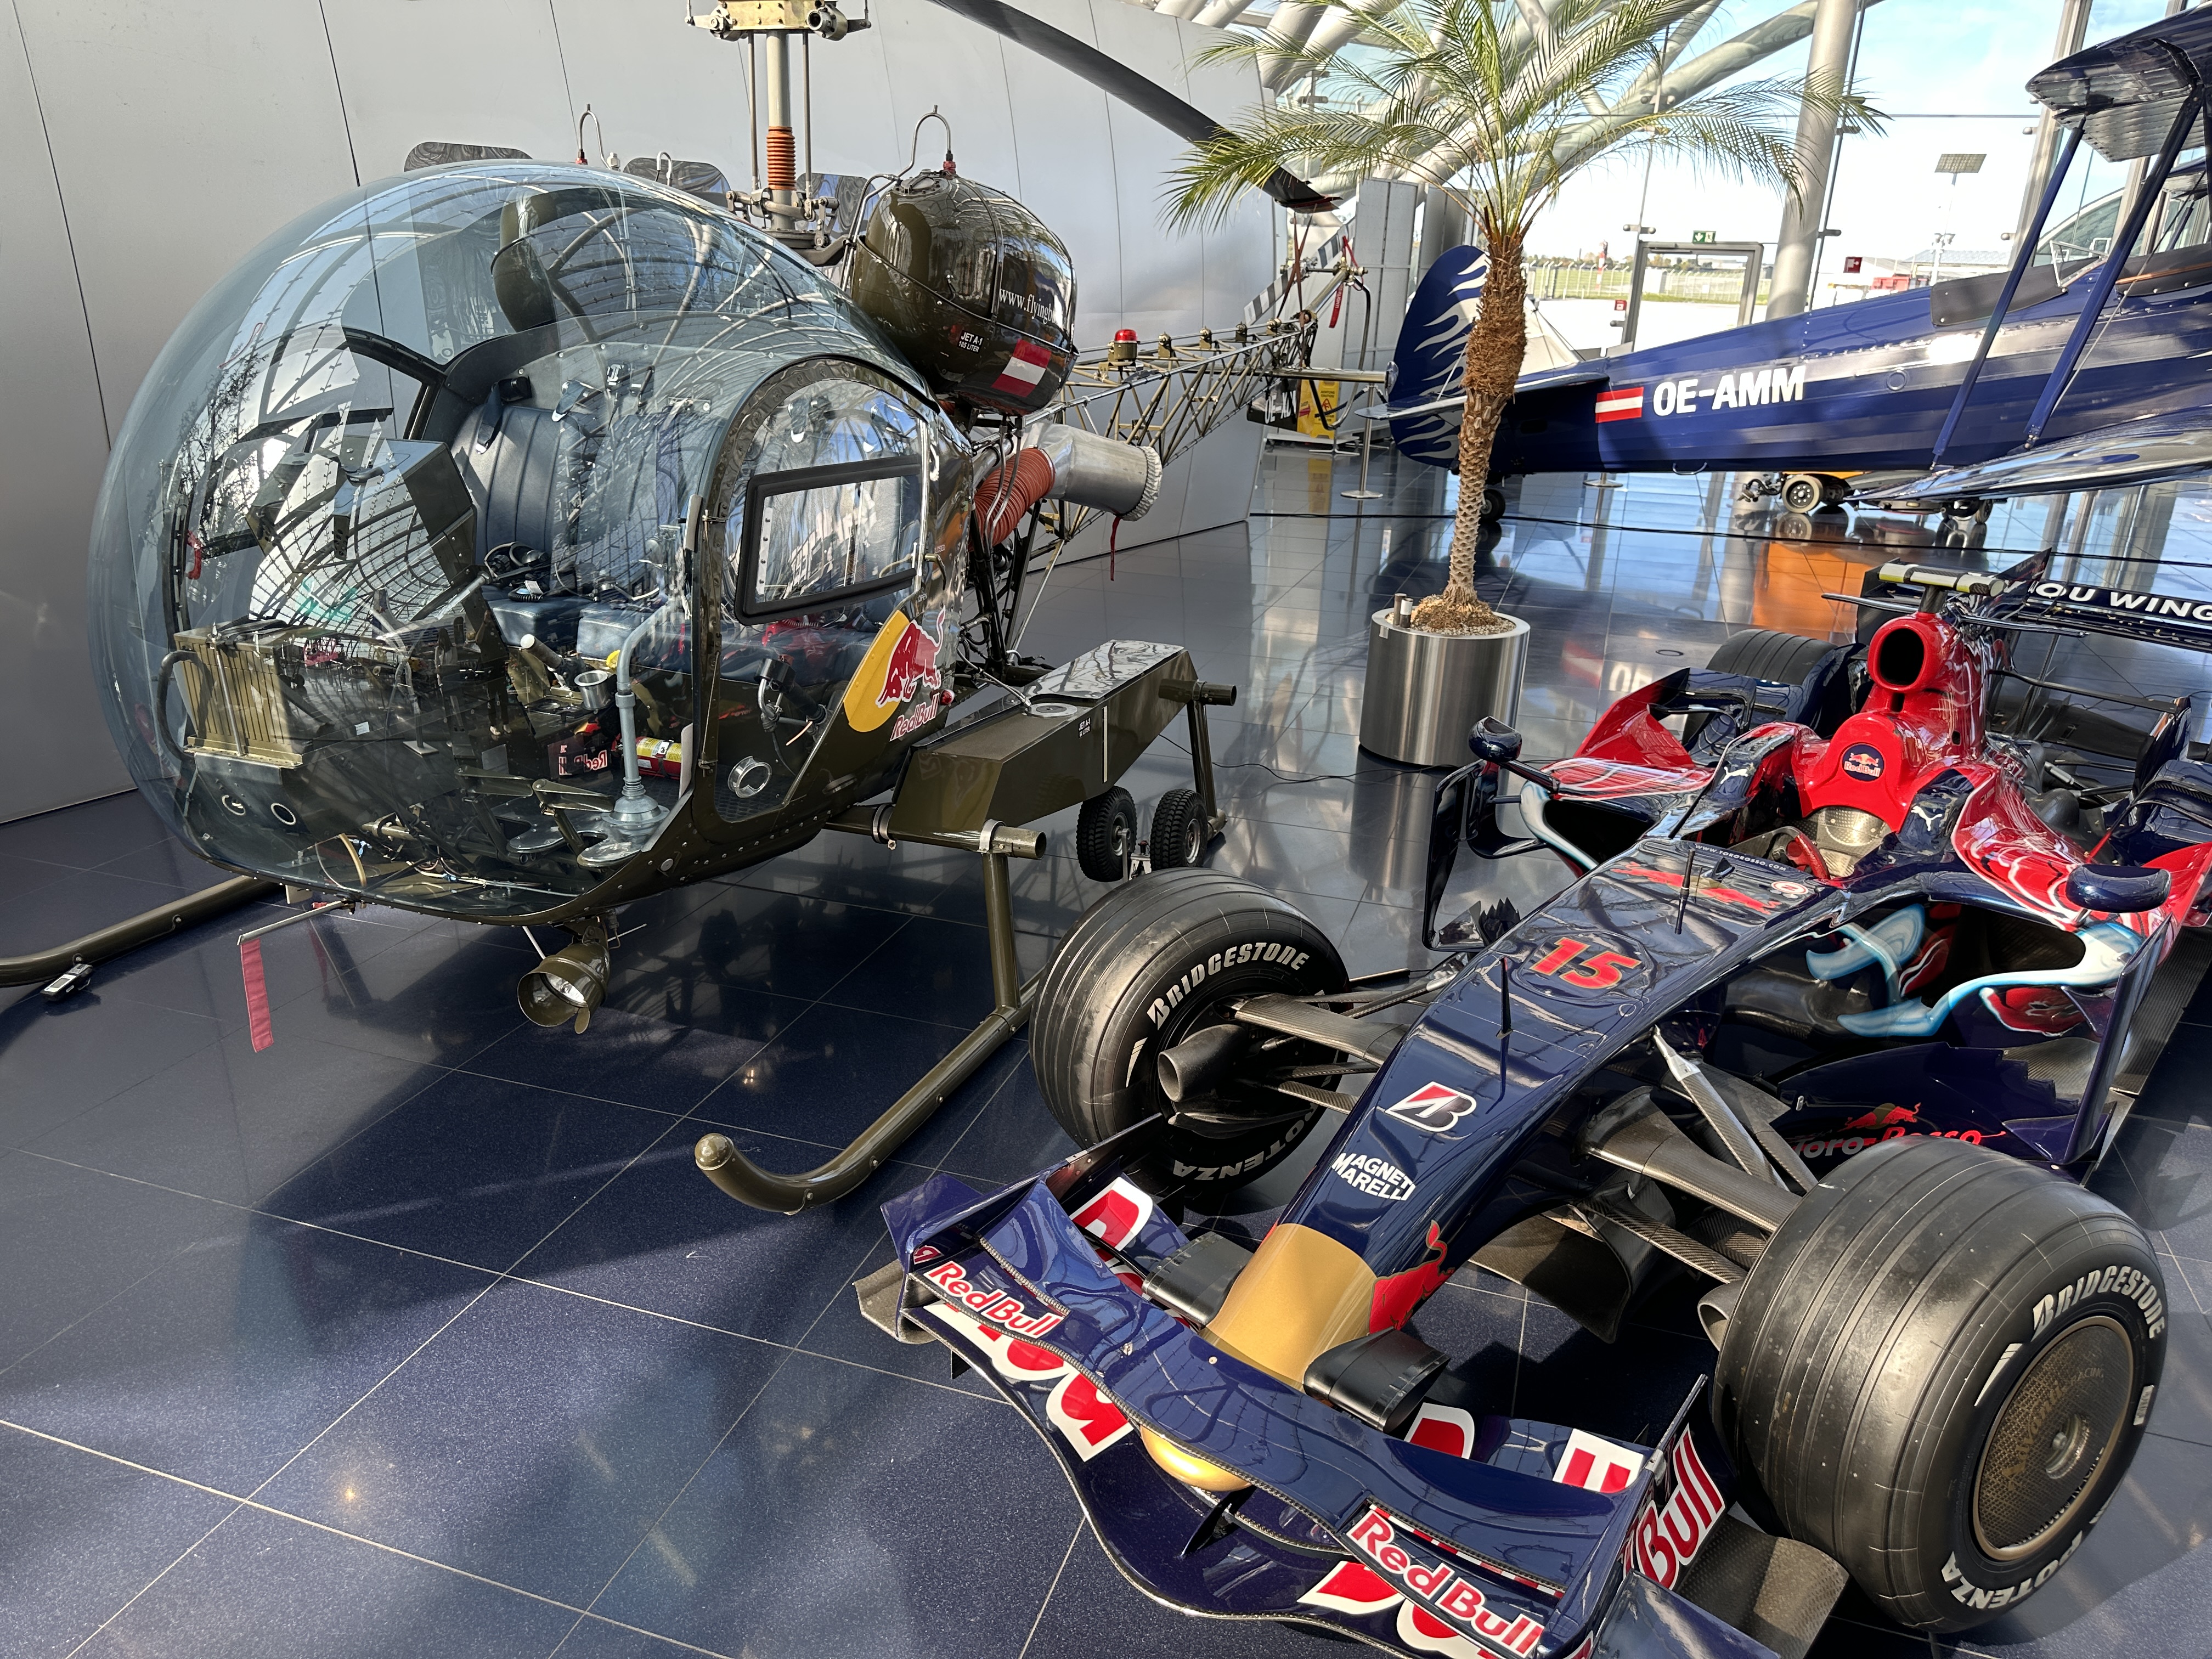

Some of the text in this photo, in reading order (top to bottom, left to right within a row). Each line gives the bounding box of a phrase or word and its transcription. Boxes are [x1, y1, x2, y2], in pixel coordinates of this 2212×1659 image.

[961, 332, 983, 346] JET A-1
[967, 343, 980, 353] LITER
[1654, 365, 1806, 416] OE-AMM
[1695, 843, 1786, 871] WWW.TOROROSSO.COM
[1147, 942, 1310, 1031] BRIDGESTONE
[1529, 936, 1642, 989] 15
[1331, 1153, 1415, 1190] MAGNETI
[2030, 1266, 2165, 1342] BRIDGESTONE
[1942, 1530, 2083, 1609] POTENZA
